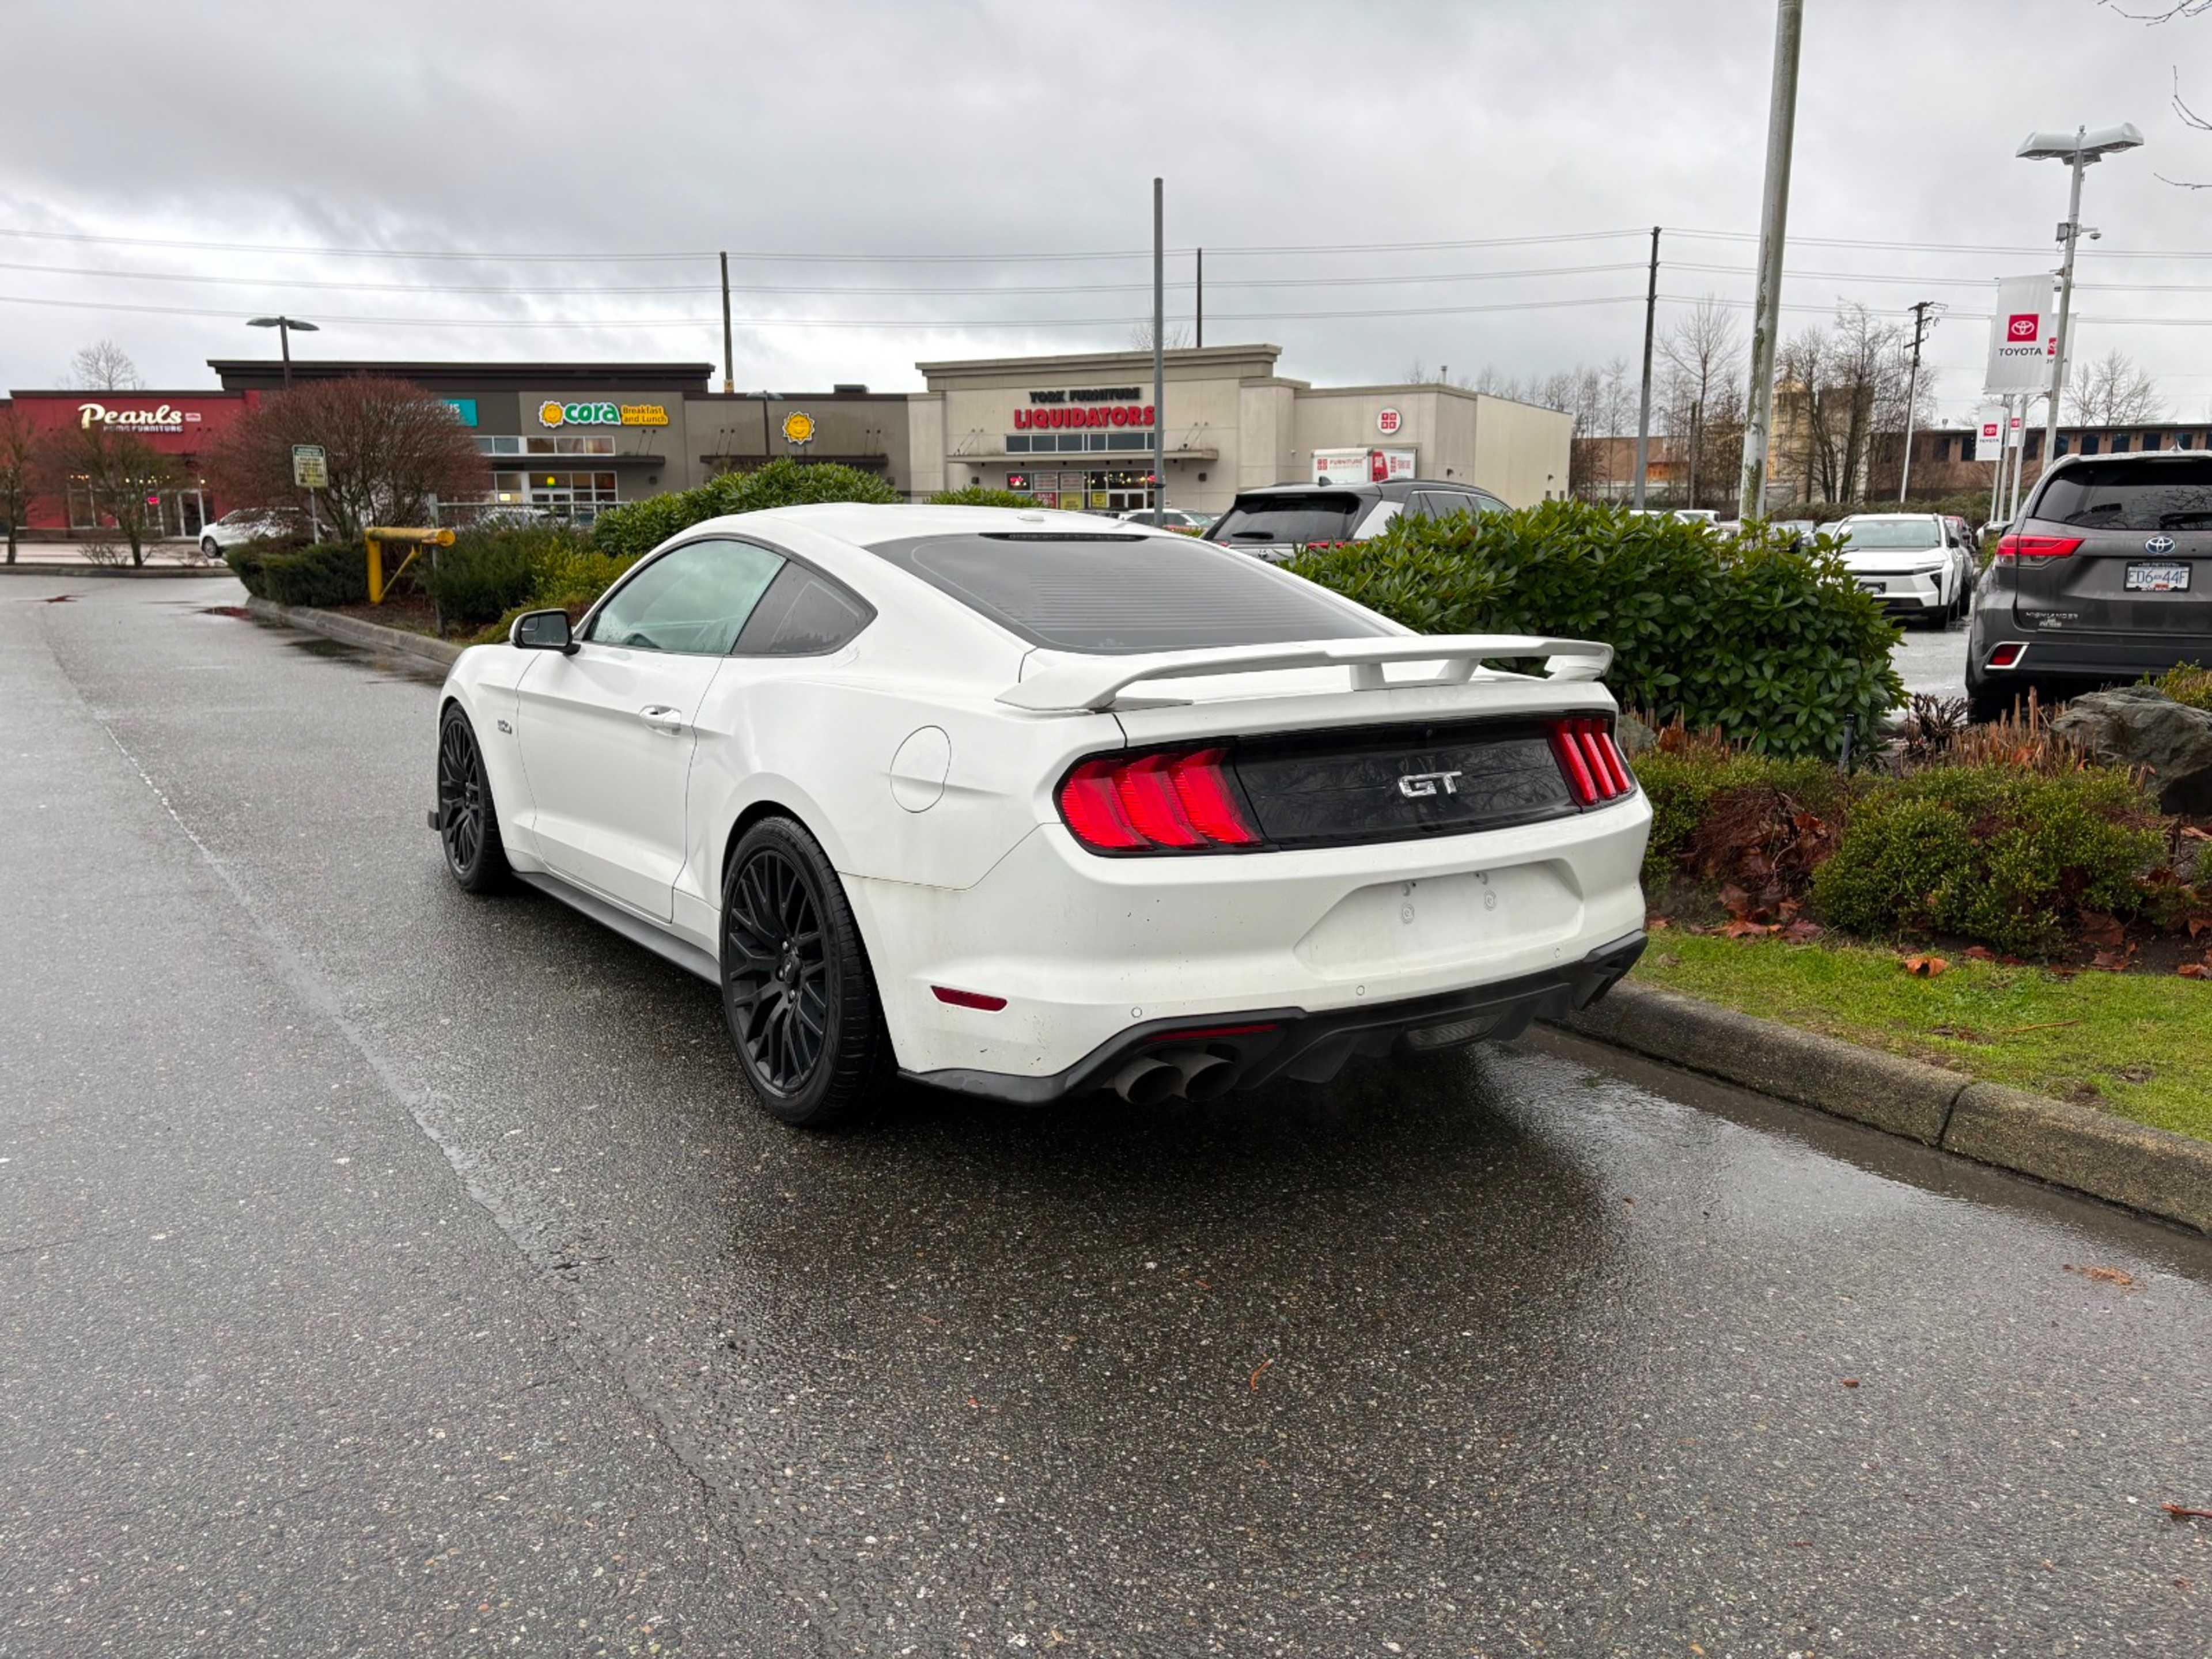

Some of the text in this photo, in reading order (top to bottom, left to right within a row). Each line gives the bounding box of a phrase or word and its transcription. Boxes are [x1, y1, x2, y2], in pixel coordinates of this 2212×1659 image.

[1998, 347, 2042, 357] TOYOTA
[1029, 387, 1141, 403] YORK FURNITURE
[78, 403, 182, 429] Pearls
[564, 404, 620, 423] cora
[623, 407, 662, 415] Breakfast
[642, 415, 667, 423] Lunch
[1014, 405, 1155, 429] LIQUIDATORS
[1398, 771, 1463, 798] GT
